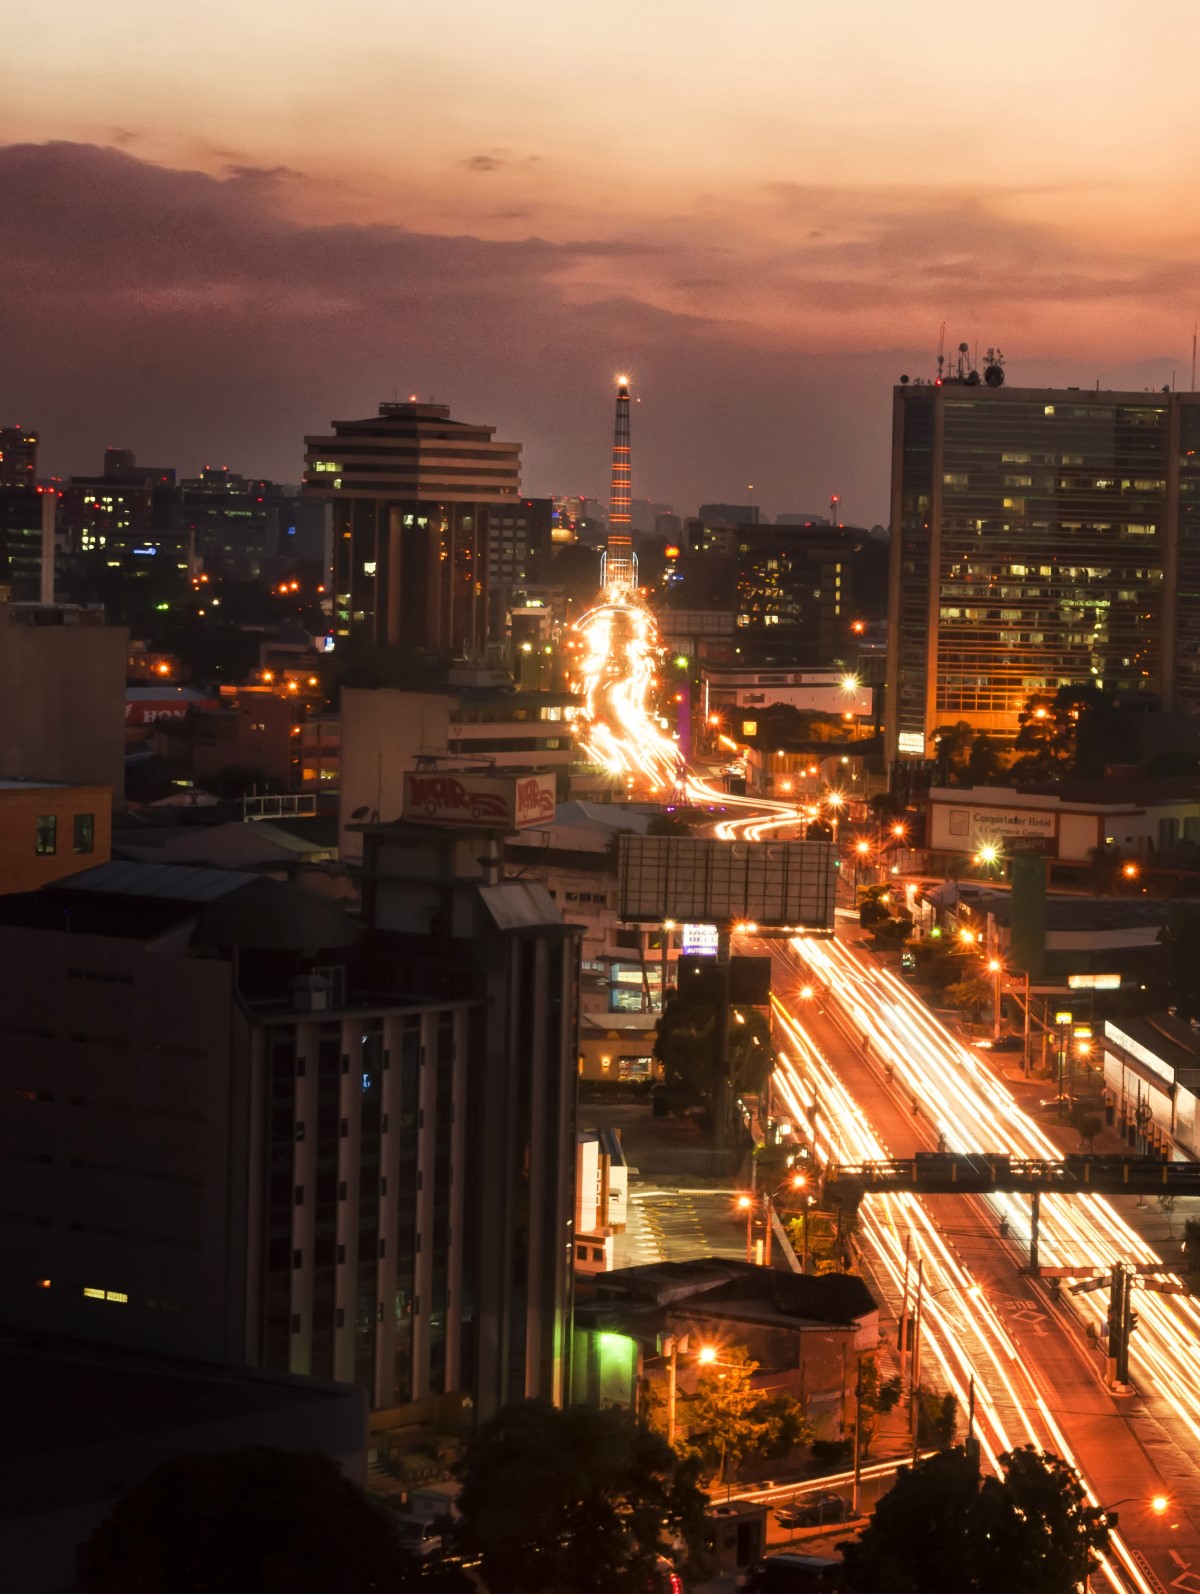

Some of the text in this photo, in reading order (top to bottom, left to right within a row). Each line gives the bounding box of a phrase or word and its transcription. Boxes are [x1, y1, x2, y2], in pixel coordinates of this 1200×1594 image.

[974, 813, 1051, 828] Conquistador Hotel
[1004, 1300, 1038, 1310] BUS
